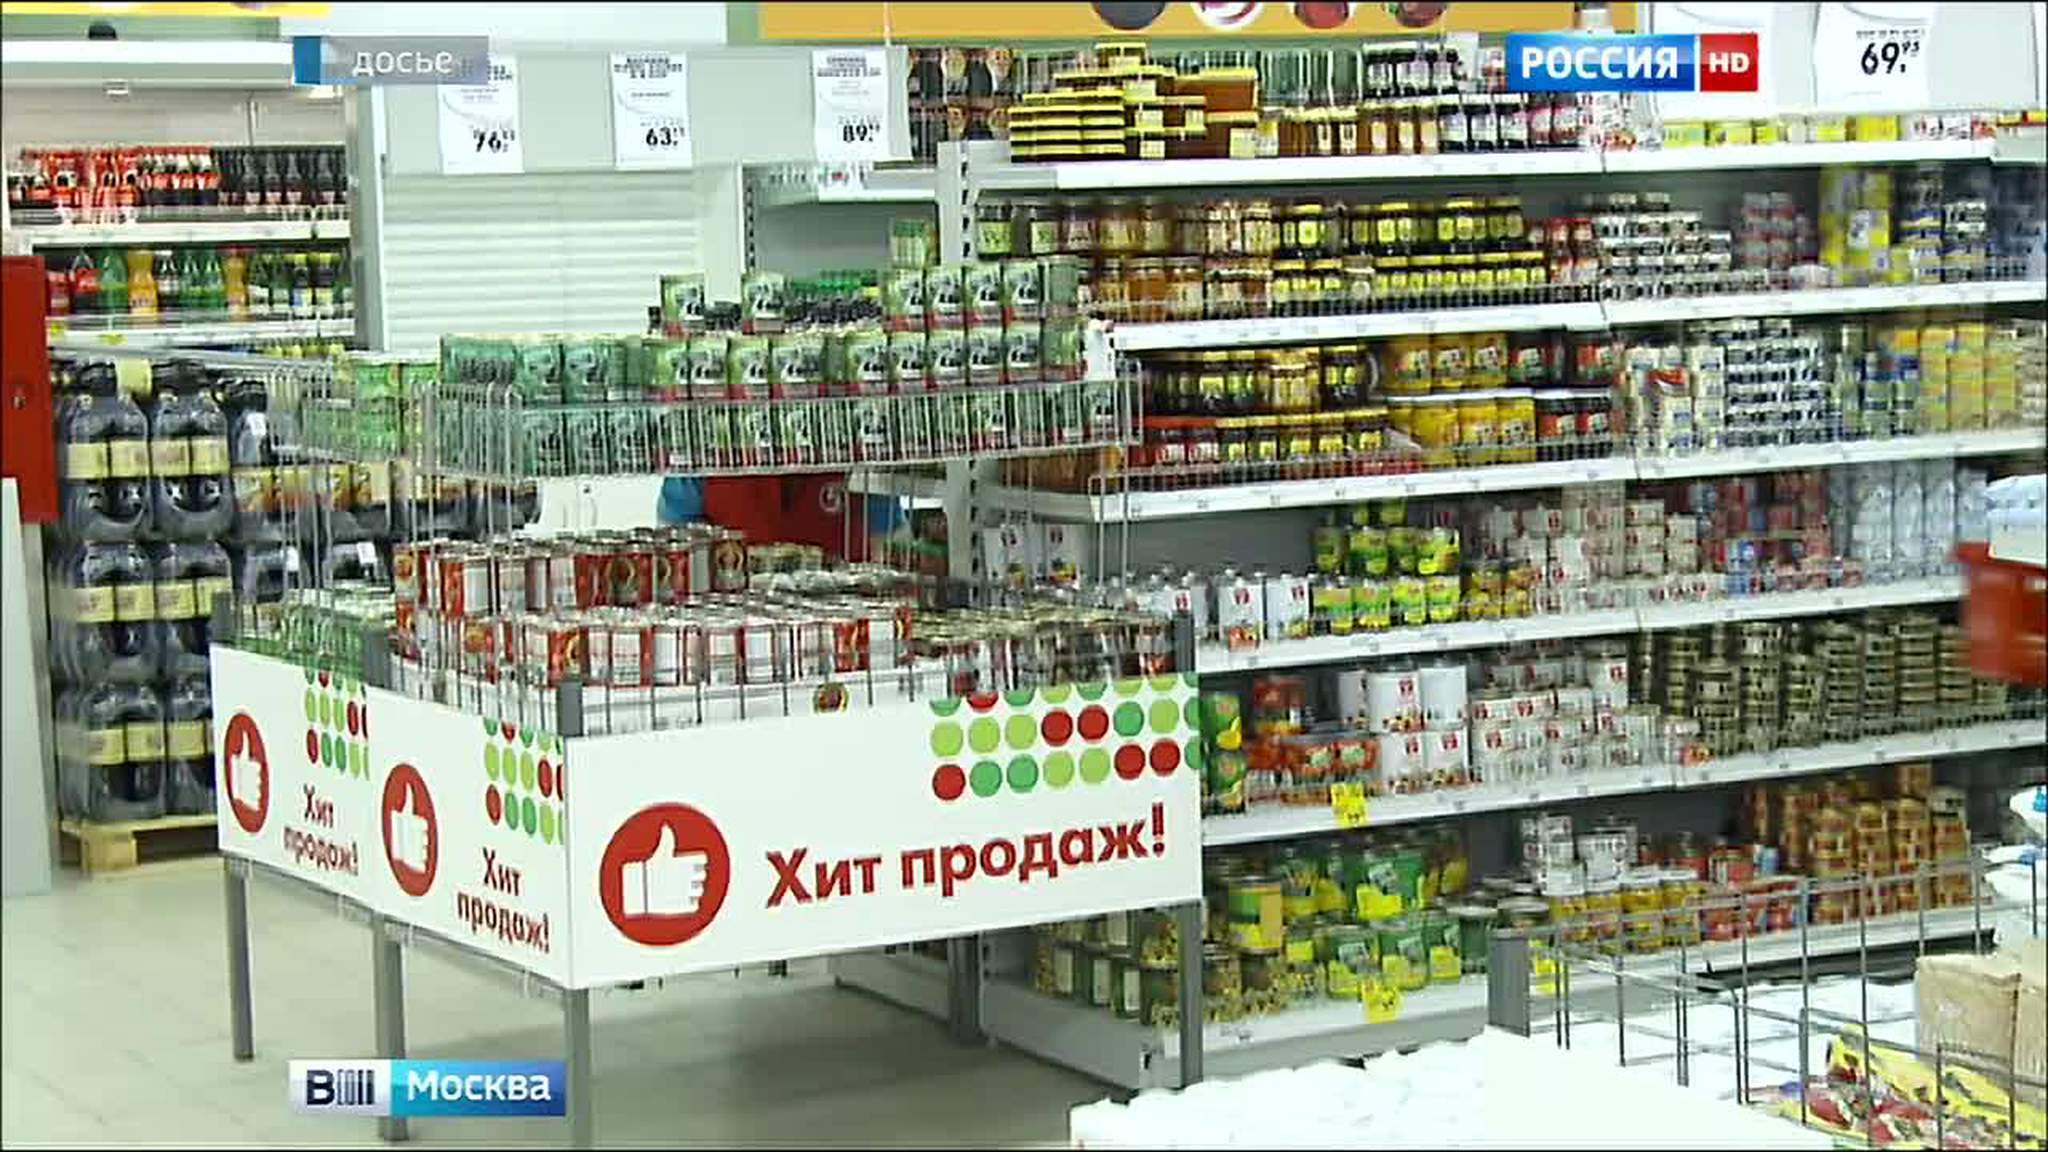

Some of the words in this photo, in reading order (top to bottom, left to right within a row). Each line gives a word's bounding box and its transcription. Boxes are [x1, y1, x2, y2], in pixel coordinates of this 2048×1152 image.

[303, 784, 335, 825] Хит
[283, 826, 359, 876] продаж!
[482, 847, 522, 898] Хит
[766, 848, 883, 908] Хит
[901, 802, 1166, 897] продаж!
[457, 891, 551, 953] продаж!
